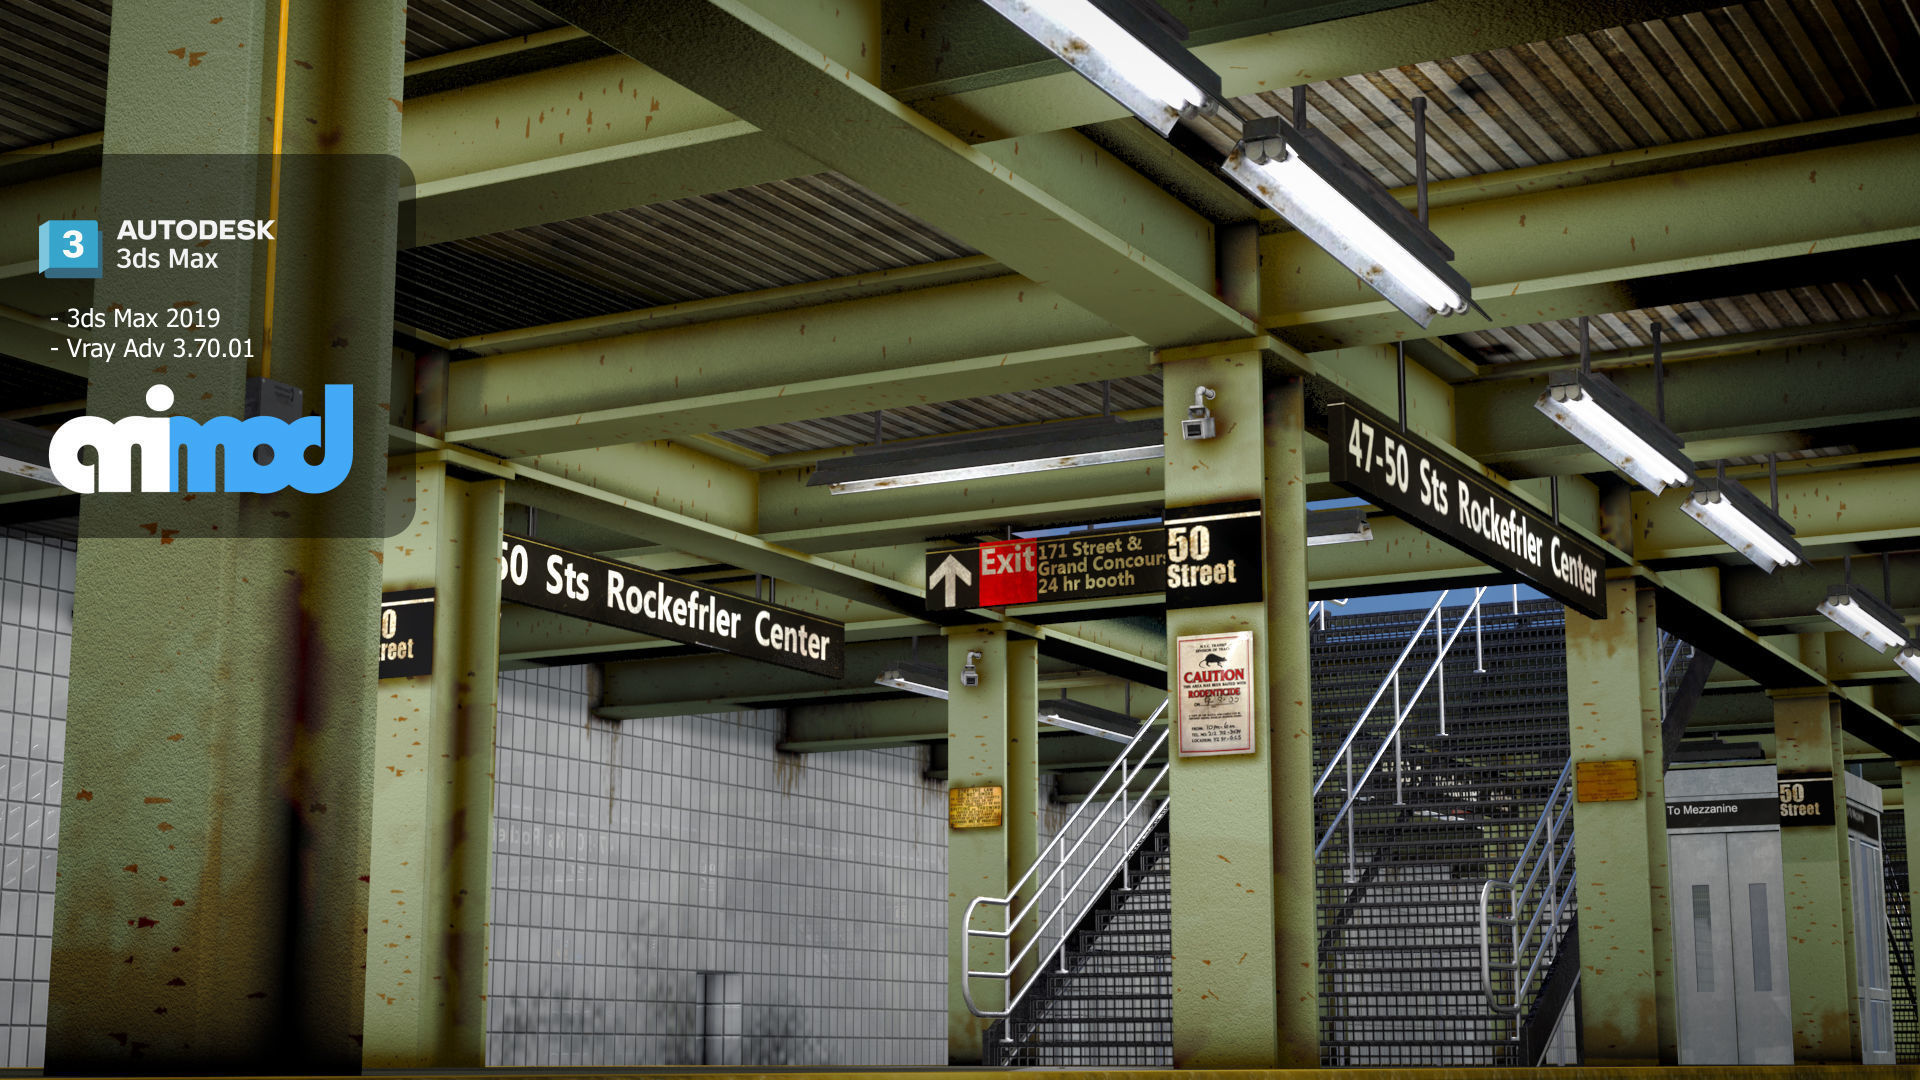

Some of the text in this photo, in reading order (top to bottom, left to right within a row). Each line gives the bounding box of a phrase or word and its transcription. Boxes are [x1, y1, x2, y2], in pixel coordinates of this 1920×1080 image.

[1349, 418, 1598, 598] 47-50 Sts Rockefrler Center
[1038, 535, 1143, 560] 171 Street &
[1168, 525, 1210, 563] 50
[981, 544, 1036, 576] Exit
[1038, 556, 1088, 576] Grand
[1038, 570, 1135, 594] 24 hr booth
[1167, 559, 1238, 589] Street
[546, 554, 590, 602] Sts
[607, 569, 741, 638] Rockefrler
[754, 611, 830, 661] Center
[378, 638, 414, 662] reet
[1183, 668, 1245, 684] CAUTION
[1188, 687, 1241, 699] RODENTICIDE
[1779, 783, 1805, 803] 50
[1667, 803, 1738, 815] To Mezzanine
[1780, 802, 1821, 817] Street
